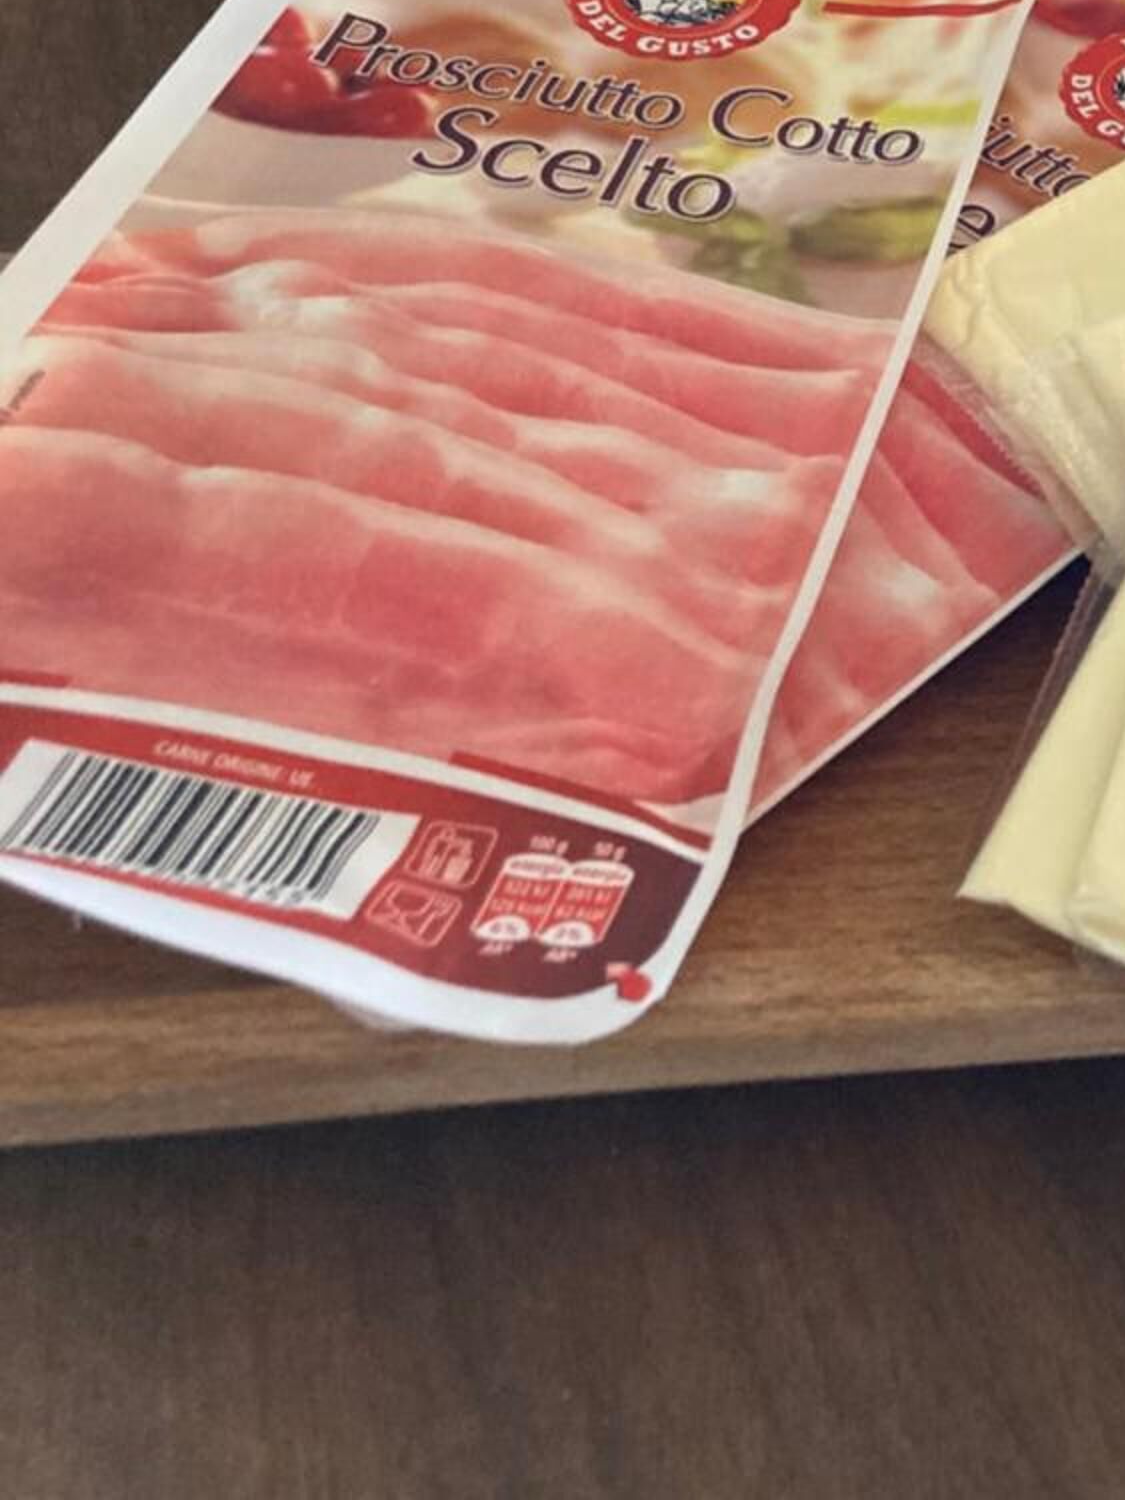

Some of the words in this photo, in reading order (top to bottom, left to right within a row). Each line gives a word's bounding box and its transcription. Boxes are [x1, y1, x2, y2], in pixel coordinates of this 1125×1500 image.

[636, 21, 762, 57] GUSTO
[312, 11, 685, 130] Prosciutto
[711, 85, 926, 166] Cotto
[1071, 72, 1094, 119] DEL
[412, 105, 736, 223] Scelto
